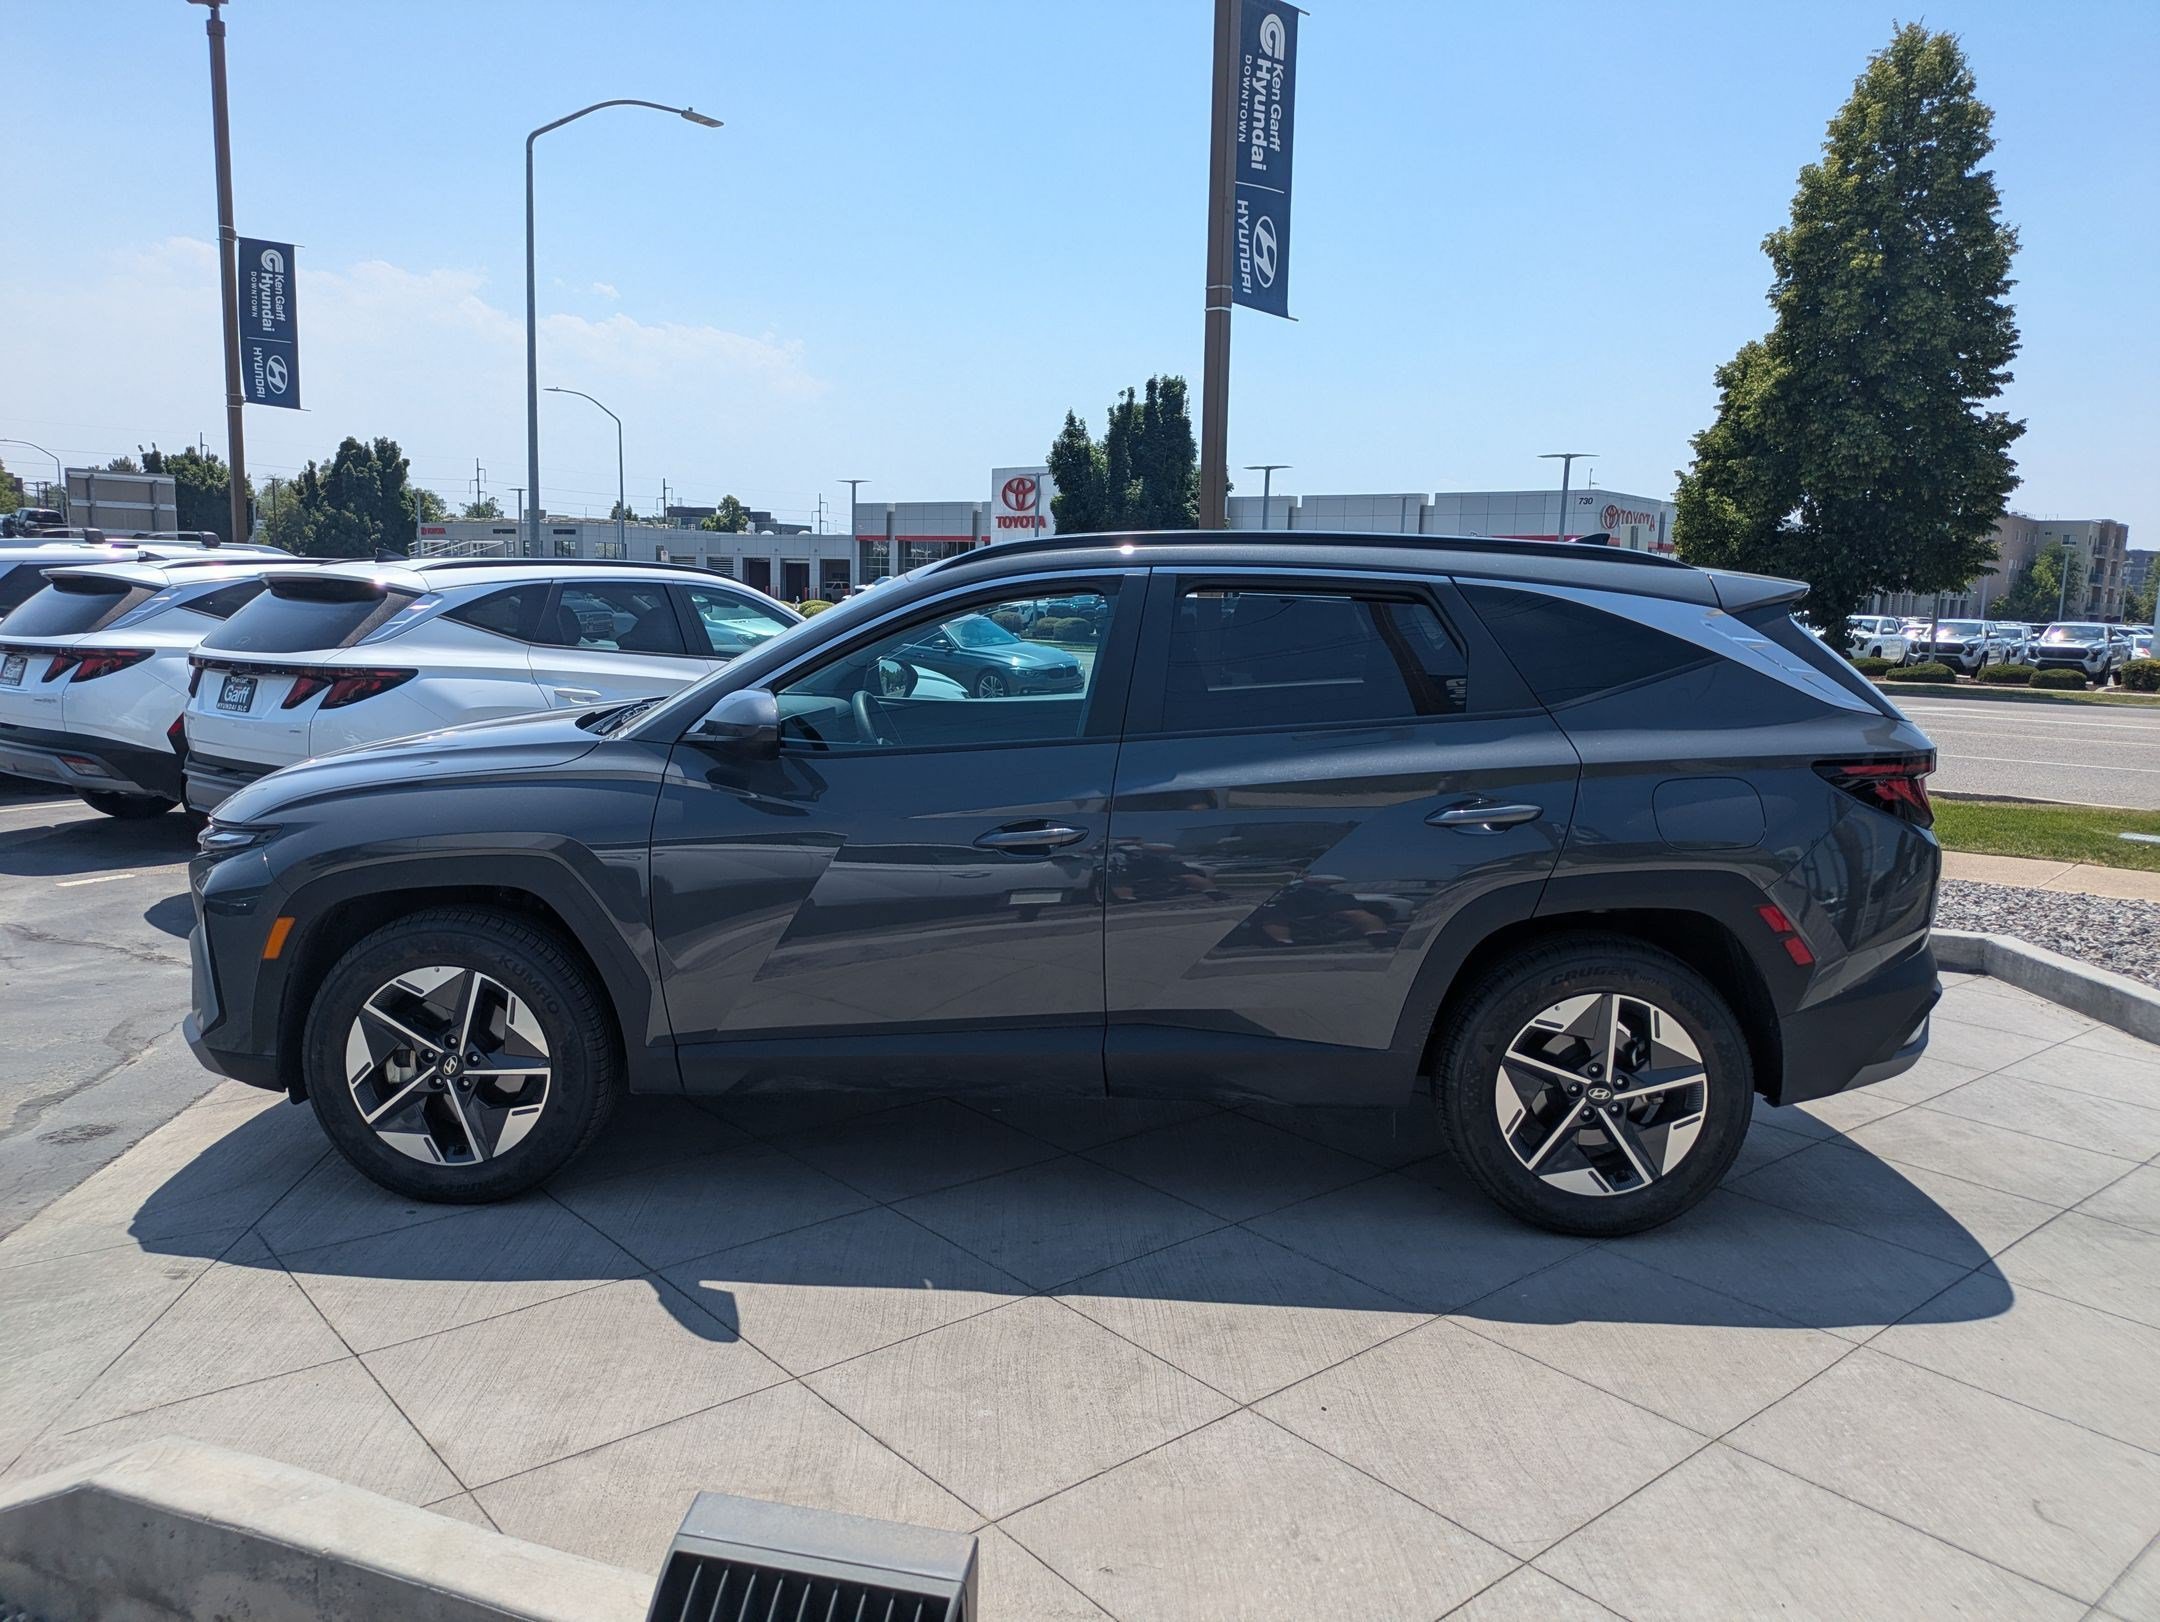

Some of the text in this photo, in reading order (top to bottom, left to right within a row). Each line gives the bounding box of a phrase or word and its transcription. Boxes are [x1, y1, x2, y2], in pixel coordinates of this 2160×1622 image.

[1238, 54, 1252, 143] DOWNTOWN
[1251, 58, 1272, 171] Hyundai
[1269, 63, 1284, 153] Ken Garff
[1237, 199, 1252, 294] HYUNDAI
[258, 272, 275, 332] Hyundai
[275, 274, 286, 322] Ken Garff
[253, 347, 266, 398] HYUNDAI
[1578, 497, 1594, 505] 730
[224, 684, 251, 704] Garff
[498, 954, 560, 1014] KUMHO
